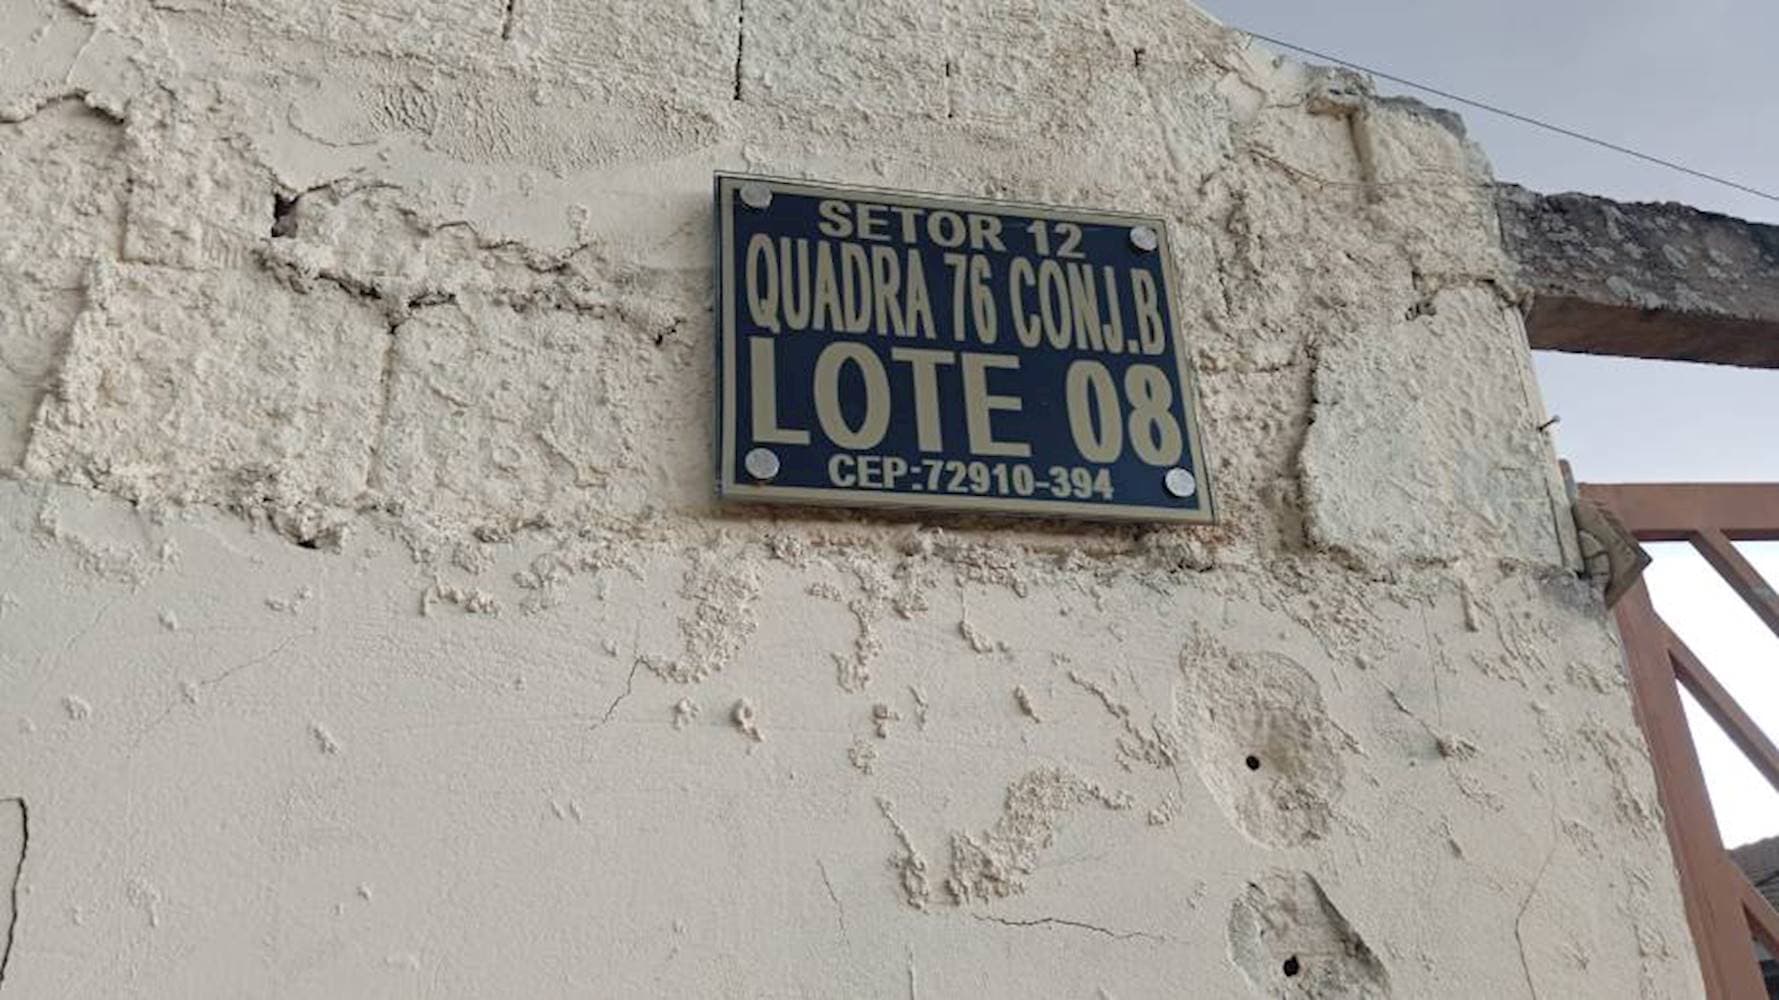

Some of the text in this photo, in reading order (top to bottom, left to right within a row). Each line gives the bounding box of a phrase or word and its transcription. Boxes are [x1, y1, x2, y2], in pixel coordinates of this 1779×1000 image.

[818, 200, 1087, 259] SETOR 12
[745, 233, 937, 340] QUADRA
[945, 252, 998, 344] 76
[749, 336, 1184, 467] LOTE 08
[828, 453, 1114, 500] CEP:72910-394
